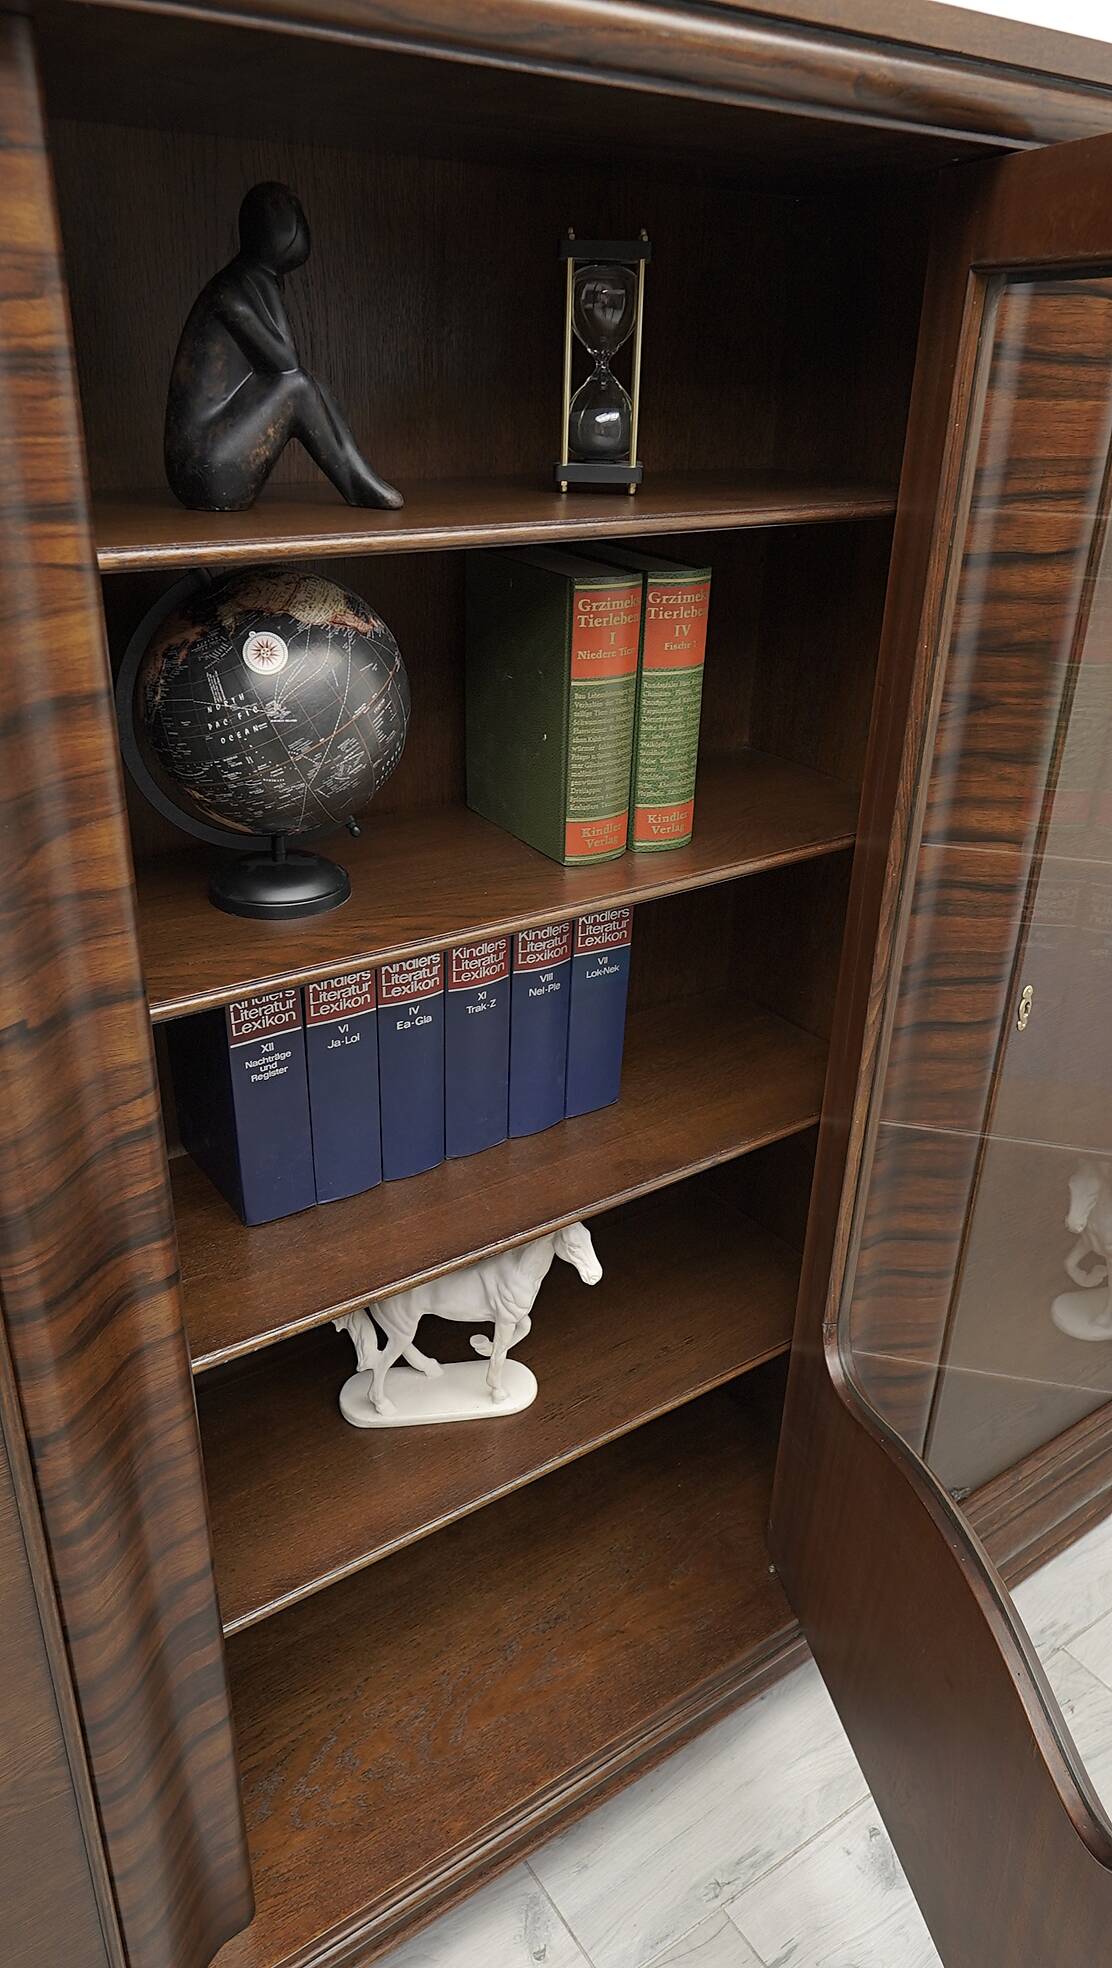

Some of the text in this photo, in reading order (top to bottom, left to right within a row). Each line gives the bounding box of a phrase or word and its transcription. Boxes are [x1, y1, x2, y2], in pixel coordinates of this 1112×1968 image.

[609, 631, 616, 645] I
[674, 623, 692, 638] IV
[207, 705, 259, 731] PACFIC
[220, 724, 259, 745] OCEAN
[651, 823, 685, 835] Verlag
[579, 908, 630, 925] Kindlers
[519, 922, 569, 941] Kindlers
[578, 919, 630, 937] Literatur
[518, 933, 569, 953] Literatur
[578, 930, 627, 948] Lexikon
[453, 939, 506, 960] Kindlers
[518, 945, 568, 964] Lexikon
[453, 950, 507, 971] Literatur
[597, 956, 608, 965] VII
[382, 964, 441, 986] Literatur
[453, 962, 505, 983] Lexikon
[540, 972, 554, 983] VIII
[309, 981, 372, 1005] Literatur
[382, 977, 440, 998] Lexikon
[478, 991, 487, 1001] XI
[230, 998, 297, 1025] Literatur
[310, 994, 371, 1017] Lexikon
[409, 1005, 420, 1016] IV
[466, 999, 497, 1014] Trak-Z
[232, 1011, 296, 1037] Lexikon
[338, 1023, 349, 1034] VI
[396, 1015, 433, 1030] Ea-Gla
[260, 1042, 275, 1054] XII
[327, 1033, 361, 1049] Ja-Lol
[245, 1051, 292, 1069] Nachträge
[260, 1061, 278, 1072] und
[251, 1066, 289, 1083] Register
